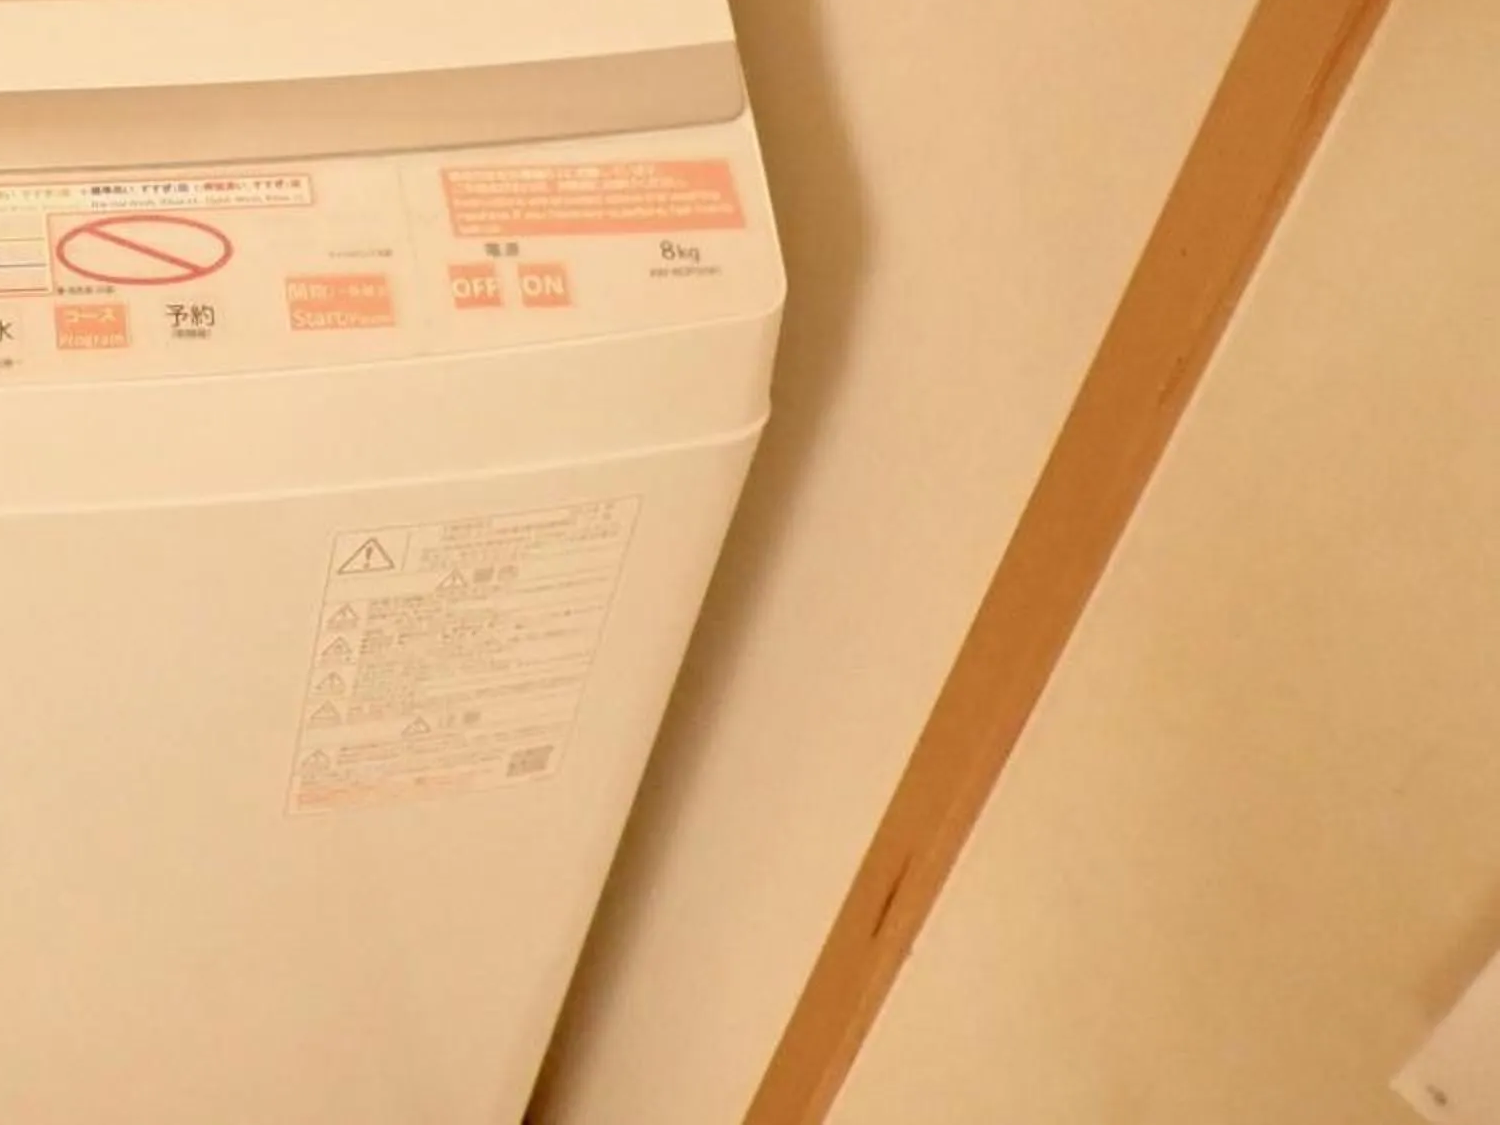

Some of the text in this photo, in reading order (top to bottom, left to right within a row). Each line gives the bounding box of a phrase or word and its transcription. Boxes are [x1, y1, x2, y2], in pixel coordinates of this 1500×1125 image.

[453, 278, 497, 299] OFF
[523, 275, 566, 297] ON
[165, 303, 216, 327] 予約
